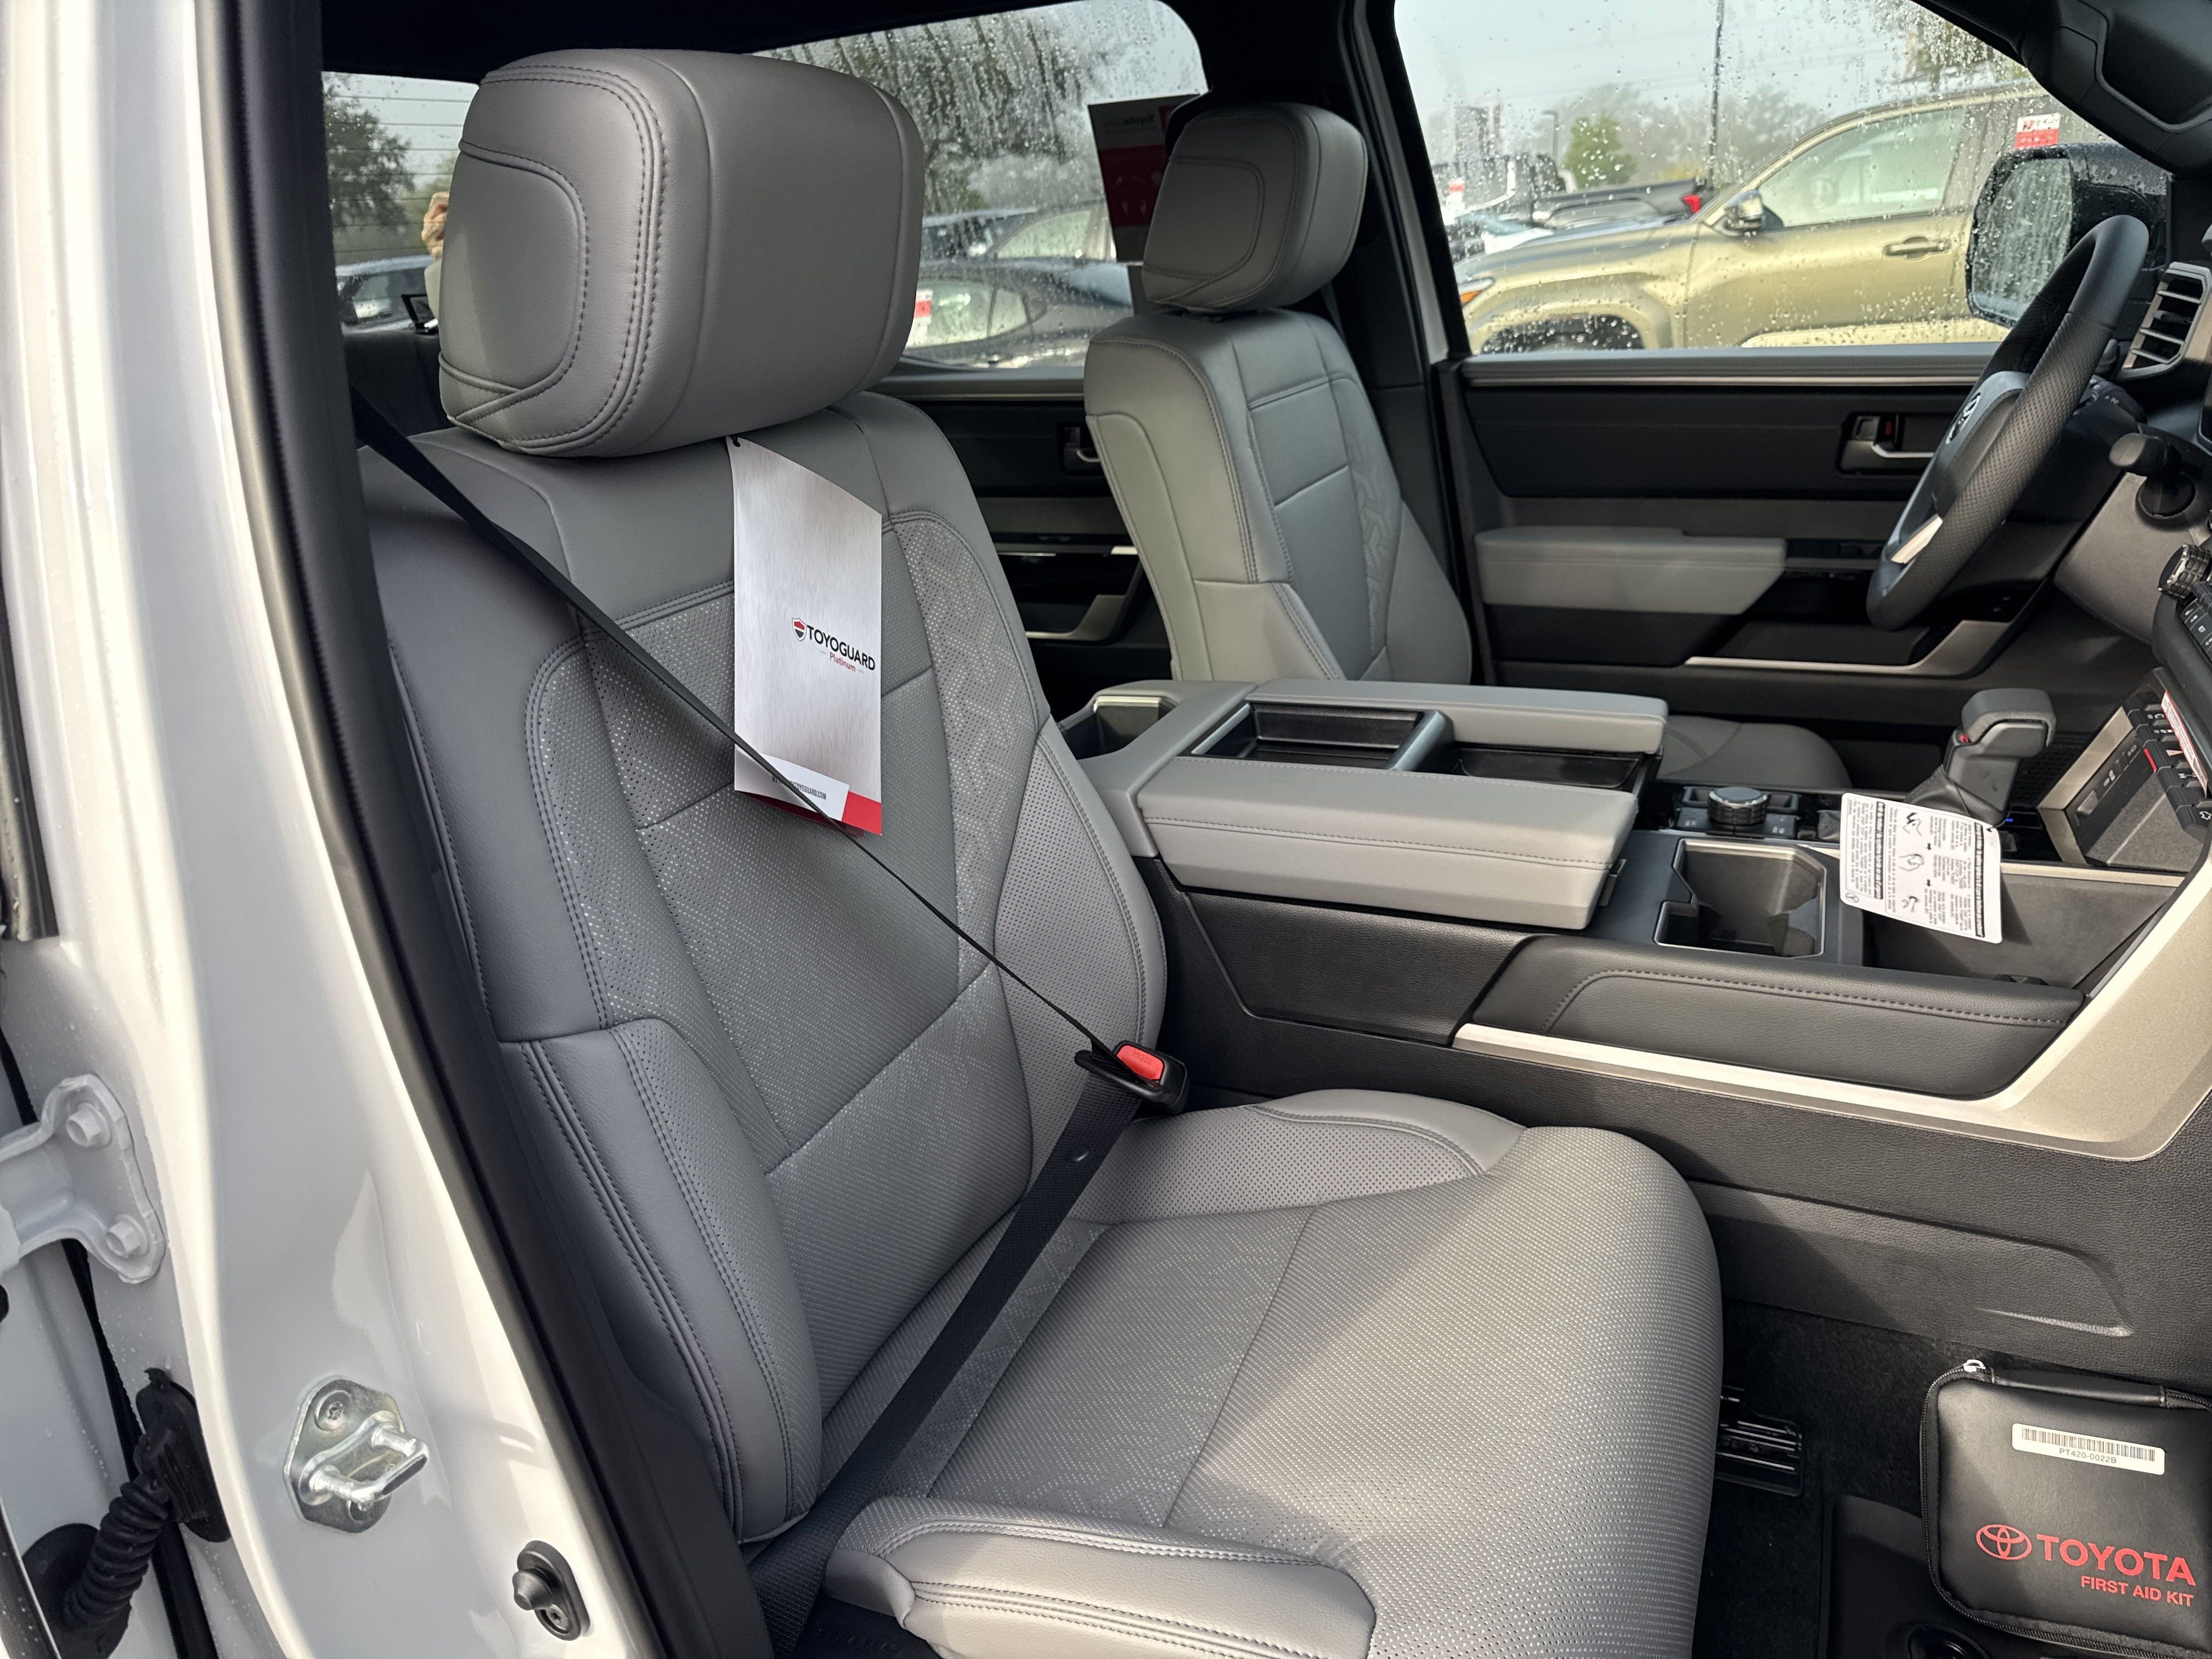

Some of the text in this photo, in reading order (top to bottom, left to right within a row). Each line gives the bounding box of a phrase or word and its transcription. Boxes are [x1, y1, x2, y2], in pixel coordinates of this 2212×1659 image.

[807, 624, 876, 671] TOYOGUARD
[829, 652, 856, 672] Platinum
[2059, 1448, 2117, 1464] PT420-0022B
[2036, 1533, 2197, 1586] TOYOTA
[2080, 1575, 2194, 1607] FIRST AID KIT
